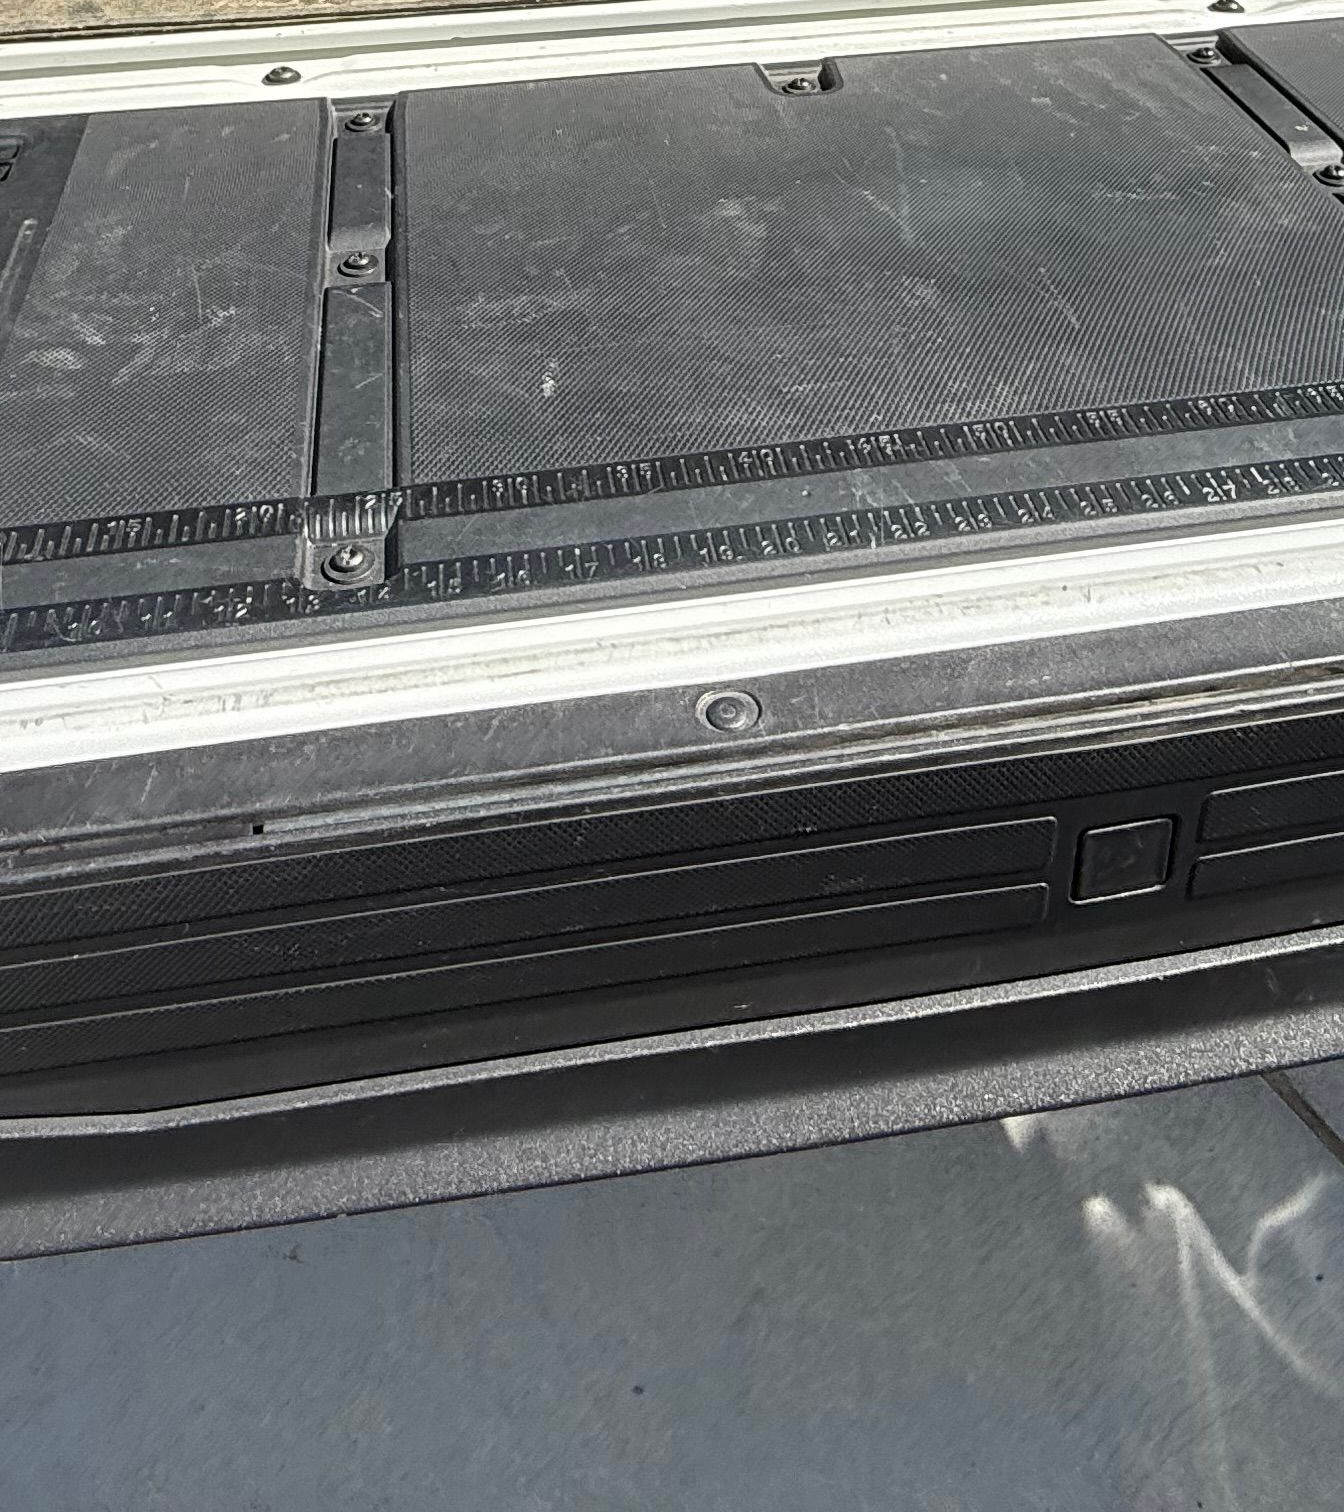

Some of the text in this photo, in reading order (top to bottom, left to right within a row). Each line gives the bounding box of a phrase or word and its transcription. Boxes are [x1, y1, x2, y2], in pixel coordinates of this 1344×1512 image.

[107, 517, 142, 535] 15
[235, 504, 274, 521] 20
[364, 490, 403, 509] 25
[615, 462, 653, 480] 35
[739, 448, 775, 465] 40
[974, 422, 1010, 440] 50
[1085, 409, 1122, 428] 55
[1197, 397, 1235, 416] 60
[1307, 385, 1344, 404] 65
[564, 560, 599, 581] 17
[632, 552, 667, 572] 18
[699, 544, 734, 565] 19
[761, 537, 800, 557] 20
[826, 529, 861, 548] 21
[890, 521, 931, 540] 22
[954, 512, 993, 532] 23
[1017, 504, 1056, 523] 24
[1079, 497, 1119, 516] 25
[1141, 490, 1181, 508] 26
[1202, 482, 1238, 503] 27
[1262, 476, 1301, 495] 28
